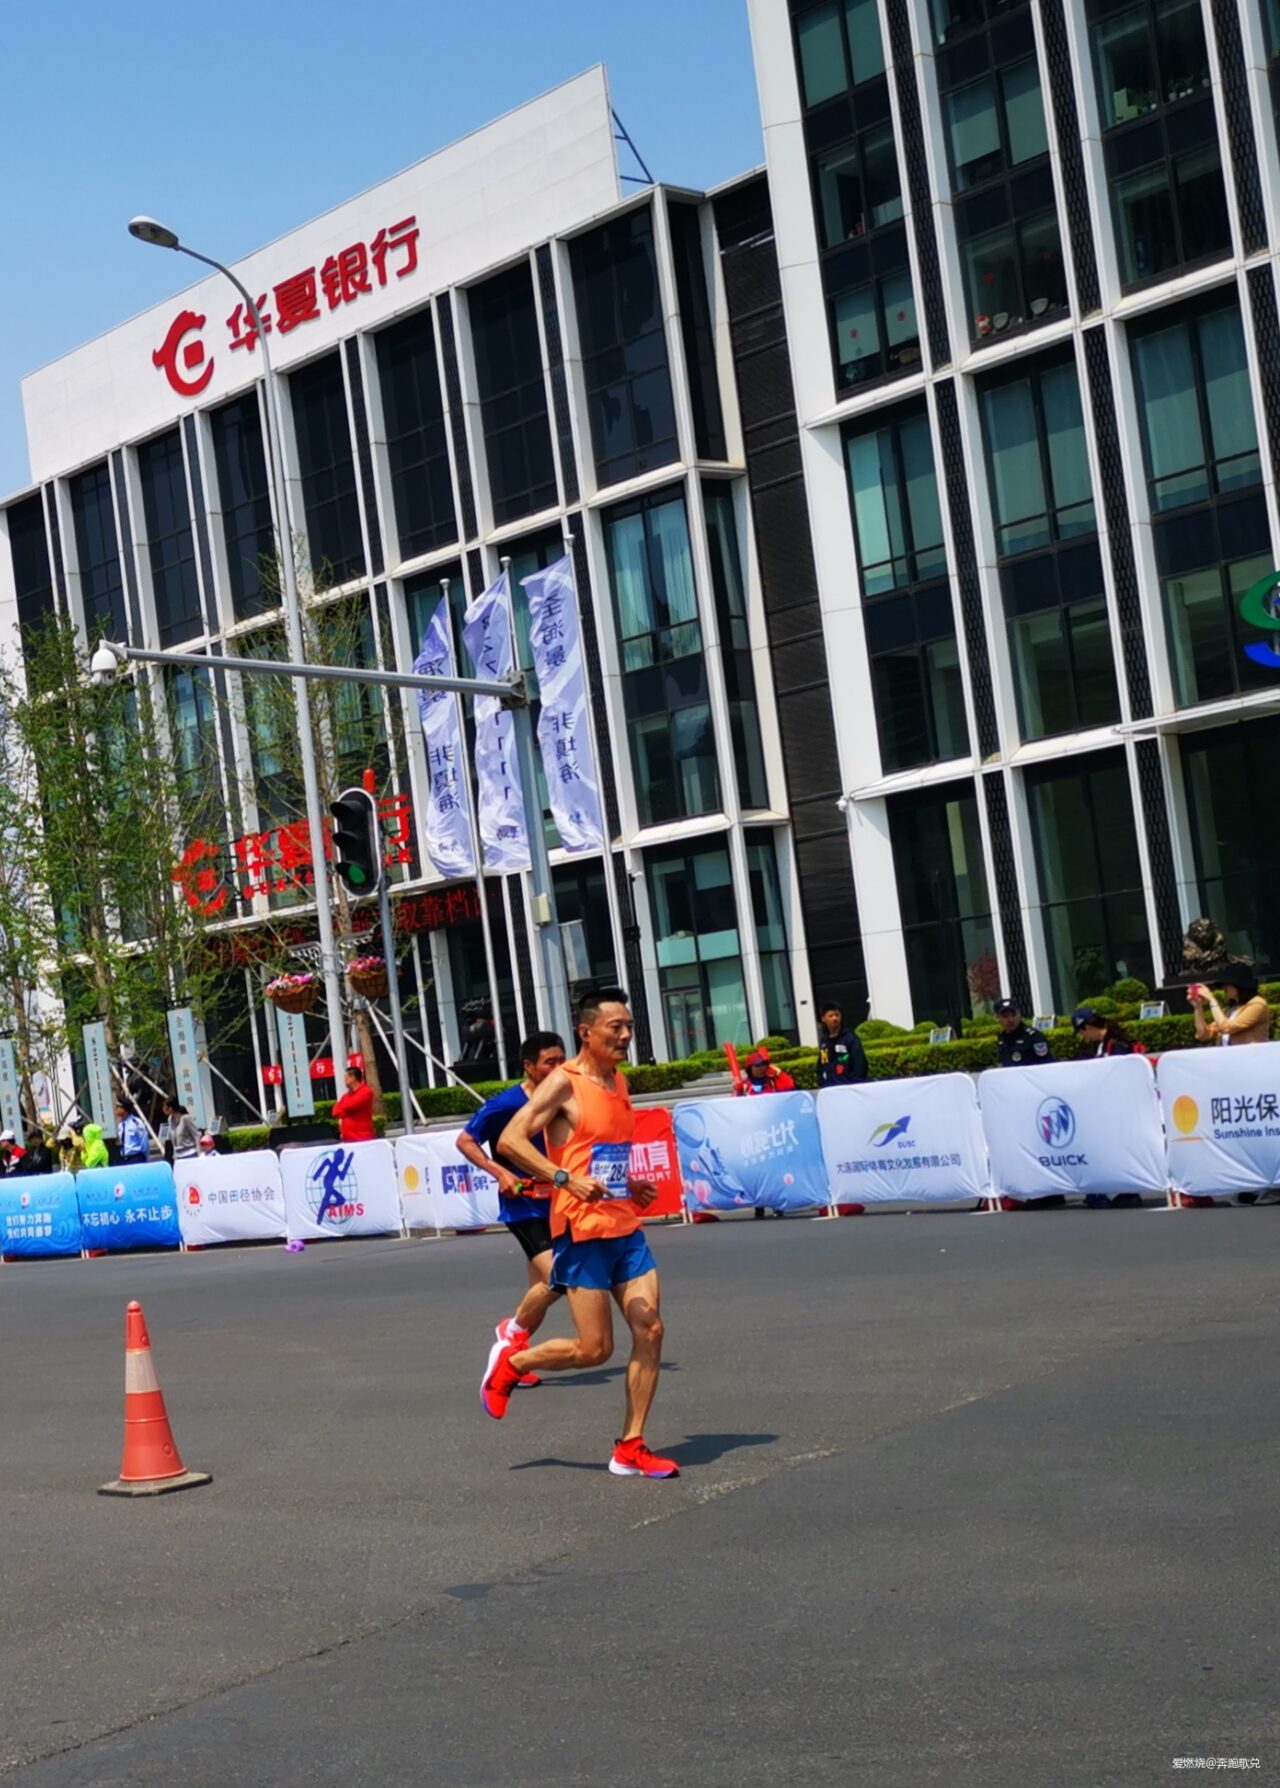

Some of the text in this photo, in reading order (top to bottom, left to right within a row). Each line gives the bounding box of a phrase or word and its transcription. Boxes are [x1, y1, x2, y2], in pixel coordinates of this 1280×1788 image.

[226, 215, 420, 351] 华夏银行
[1211, 1093, 1280, 1125] 阳光保
[1214, 1127, 1263, 1140] Sunshine
[1038, 1153, 1089, 1168] BUICK
[208, 1186, 276, 1206] 中国田径协会
[125, 1204, 173, 1223] 永不止步
[327, 1203, 365, 1218] AIMS
